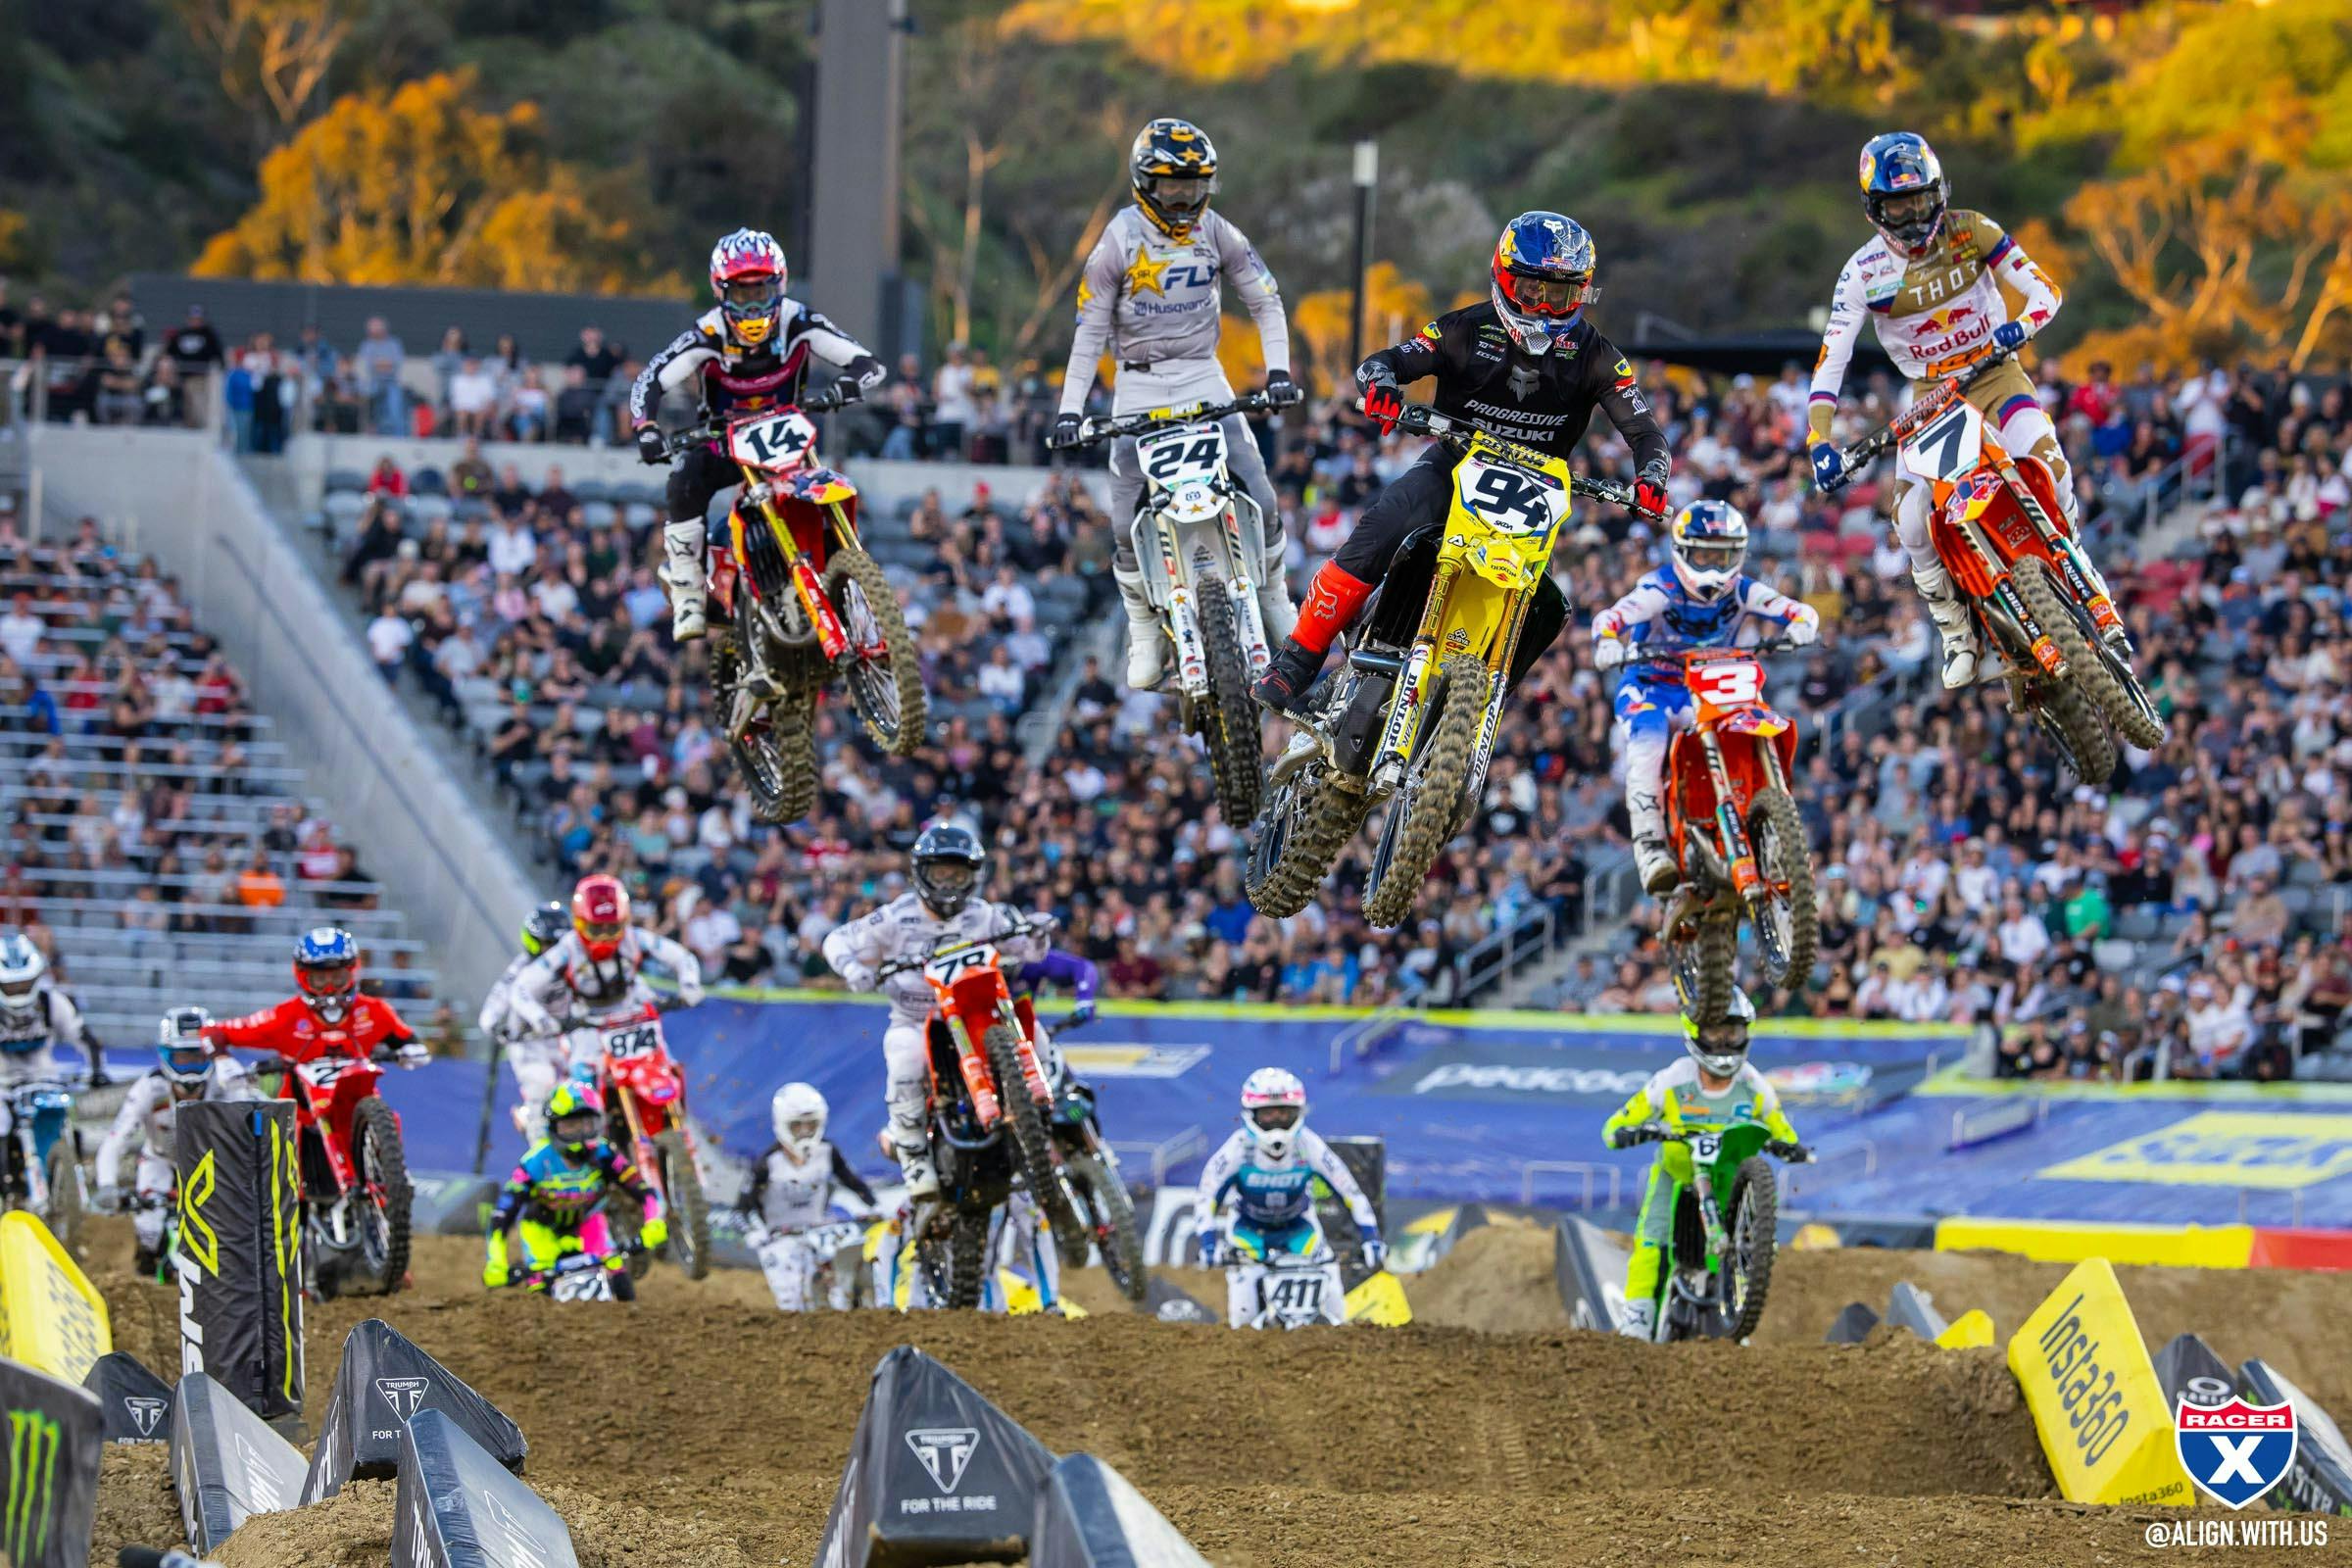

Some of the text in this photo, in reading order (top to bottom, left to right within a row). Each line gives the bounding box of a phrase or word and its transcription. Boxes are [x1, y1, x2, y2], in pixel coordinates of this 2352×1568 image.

[1164, 265, 1219, 290] FLY
[1909, 314, 1990, 360] Red Bull
[1464, 399, 1568, 425] PROGRESSIVE
[1471, 417, 1554, 441] SUZUKI
[745, 418, 808, 462] 14
[1149, 438, 1222, 479] 24
[1918, 409, 1967, 480] 7
[1470, 468, 1547, 530] 94
[1700, 664, 1758, 705] 3
[1389, 674, 1418, 747] DUNLOP
[1475, 705, 1495, 777] DUNLOP
[611, 1026, 657, 1059] 874
[1414, 1062, 1656, 1096] peacoc
[1271, 1278, 1322, 1308] 411
[2040, 1294, 2130, 1468] Insta360
[372, 1431, 392, 1440] FOR
[901, 1495, 997, 1514] FOR THE RIDE
